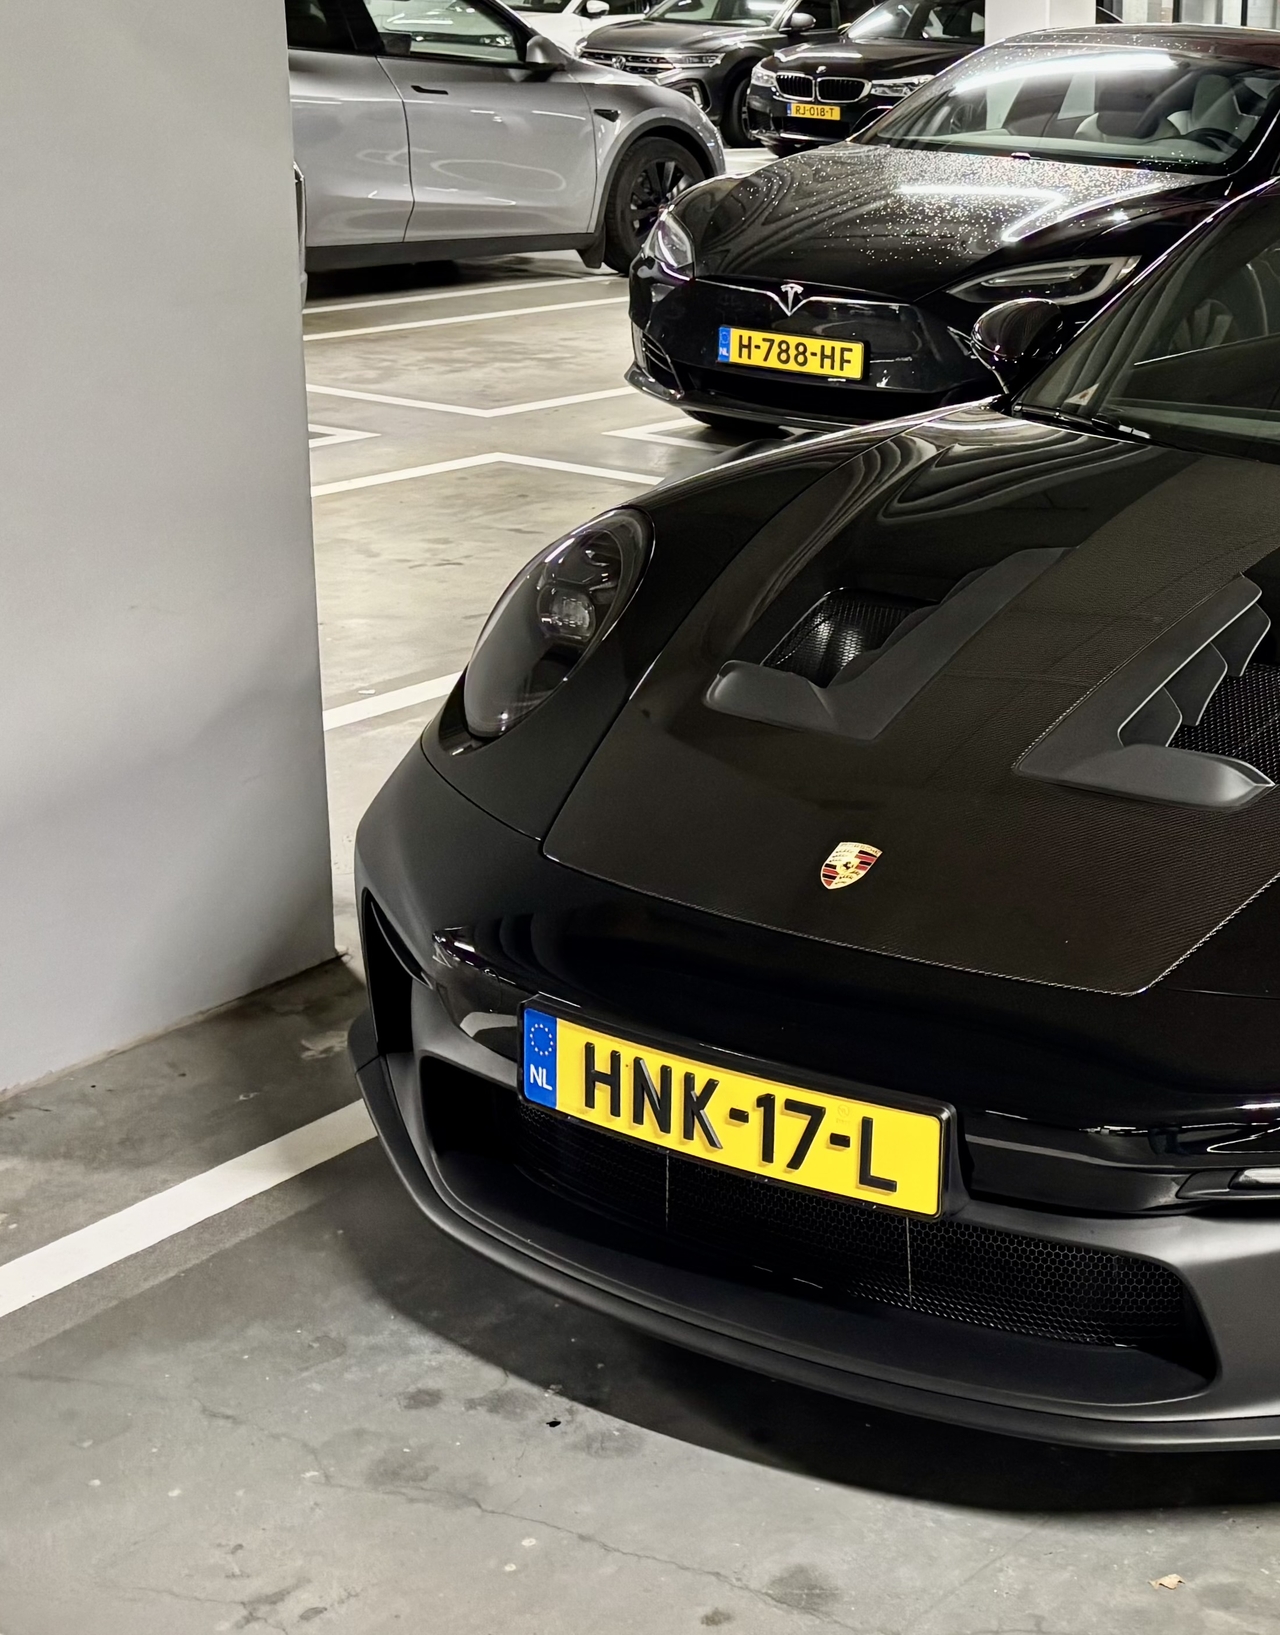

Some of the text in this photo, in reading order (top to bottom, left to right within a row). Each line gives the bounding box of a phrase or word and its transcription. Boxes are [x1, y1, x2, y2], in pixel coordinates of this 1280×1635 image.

[795, 105, 835, 117] RJ-018-T
[738, 334, 853, 372] H-788-HF
[529, 1063, 553, 1091] NL
[584, 1041, 897, 1193] HNK-17-L
